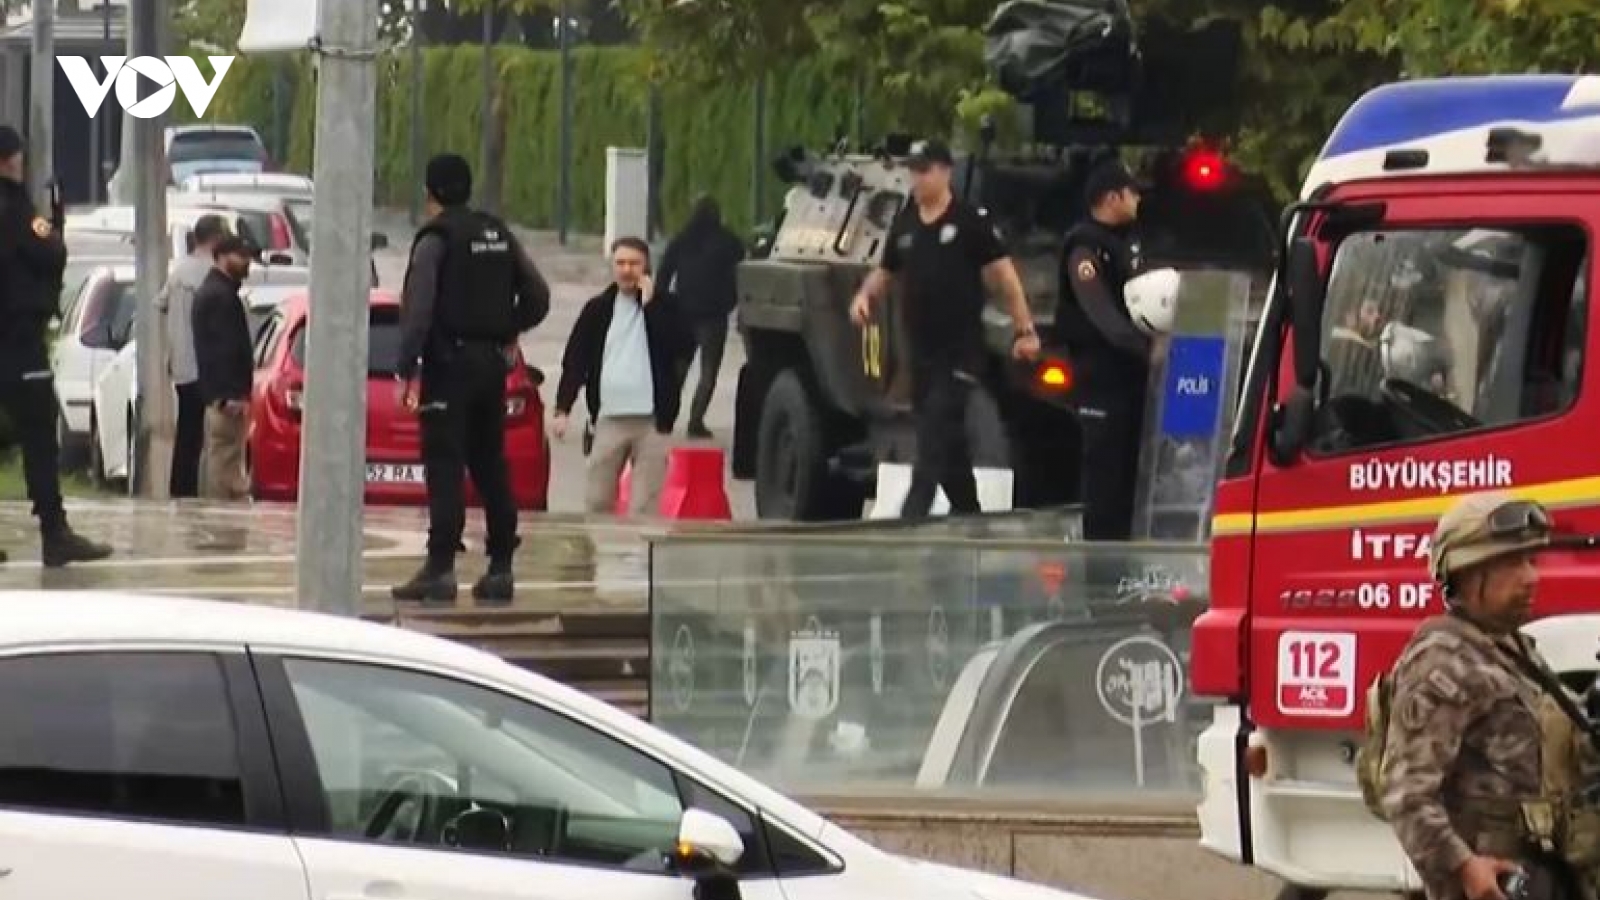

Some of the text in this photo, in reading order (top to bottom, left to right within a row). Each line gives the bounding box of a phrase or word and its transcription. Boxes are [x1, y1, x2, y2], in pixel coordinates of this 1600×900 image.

[1349, 452, 1513, 494] BÜYÜKŞEHİR
[1358, 582, 1391, 609] 06
[1400, 582, 1434, 609] DF
[1288, 640, 1341, 678] 112
